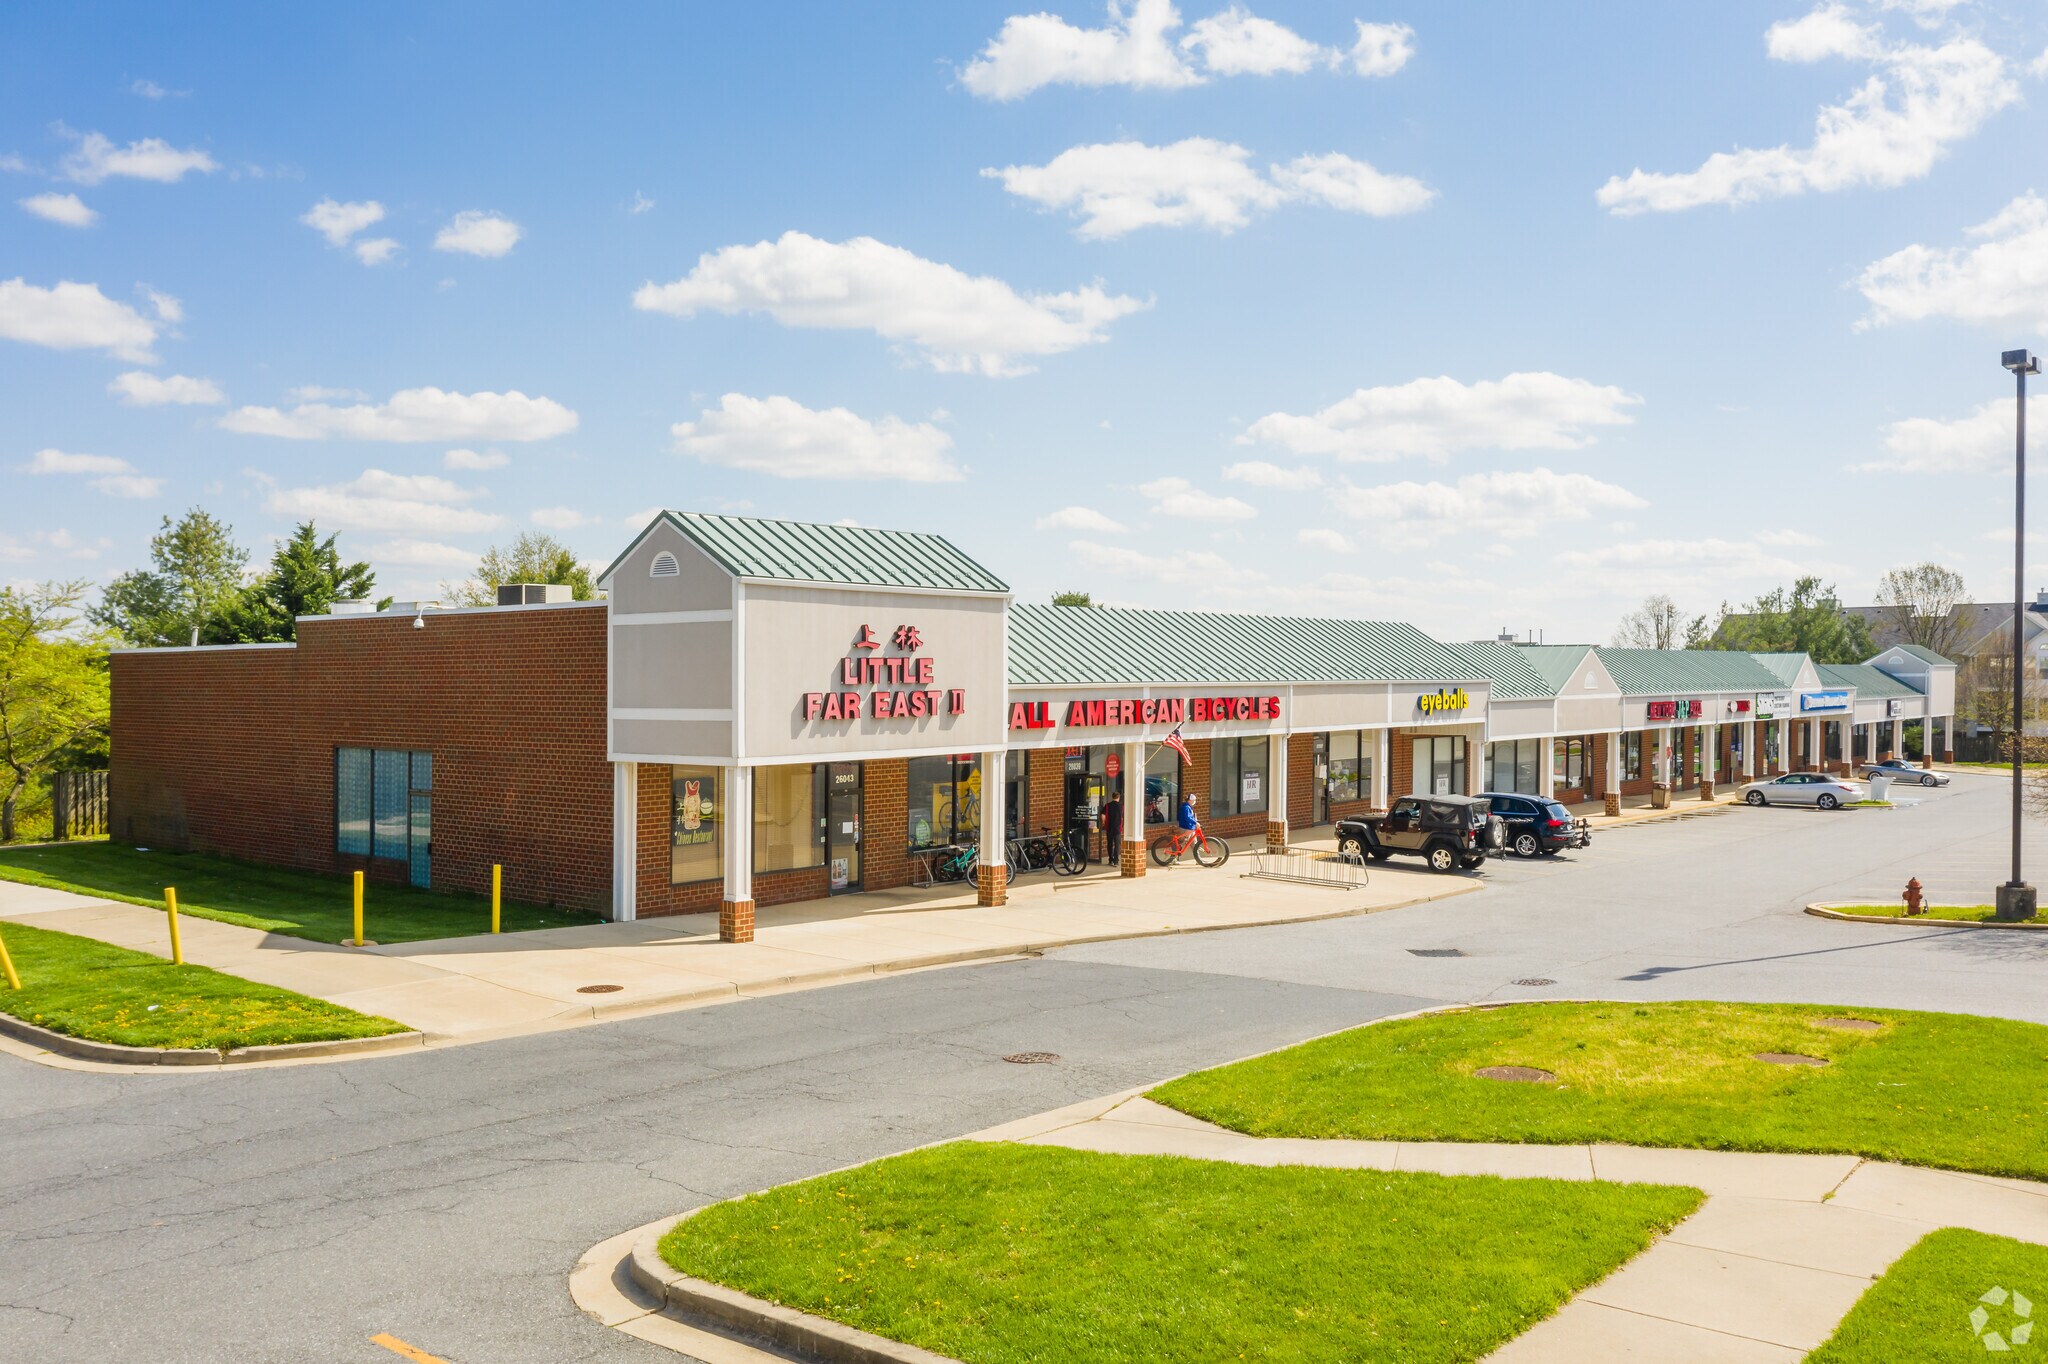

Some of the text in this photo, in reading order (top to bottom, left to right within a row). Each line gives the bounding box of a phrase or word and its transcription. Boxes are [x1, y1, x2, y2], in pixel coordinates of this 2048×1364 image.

[854, 624, 923, 652] 上林
[842, 657, 934, 685] LITTLE
[804, 689, 965, 720] FAR EAST II
[1008, 696, 1280, 729] ALL AMERICAN BICYCLES
[1418, 688, 1469, 715] eyeballs
[835, 774, 854, 784] 26043
